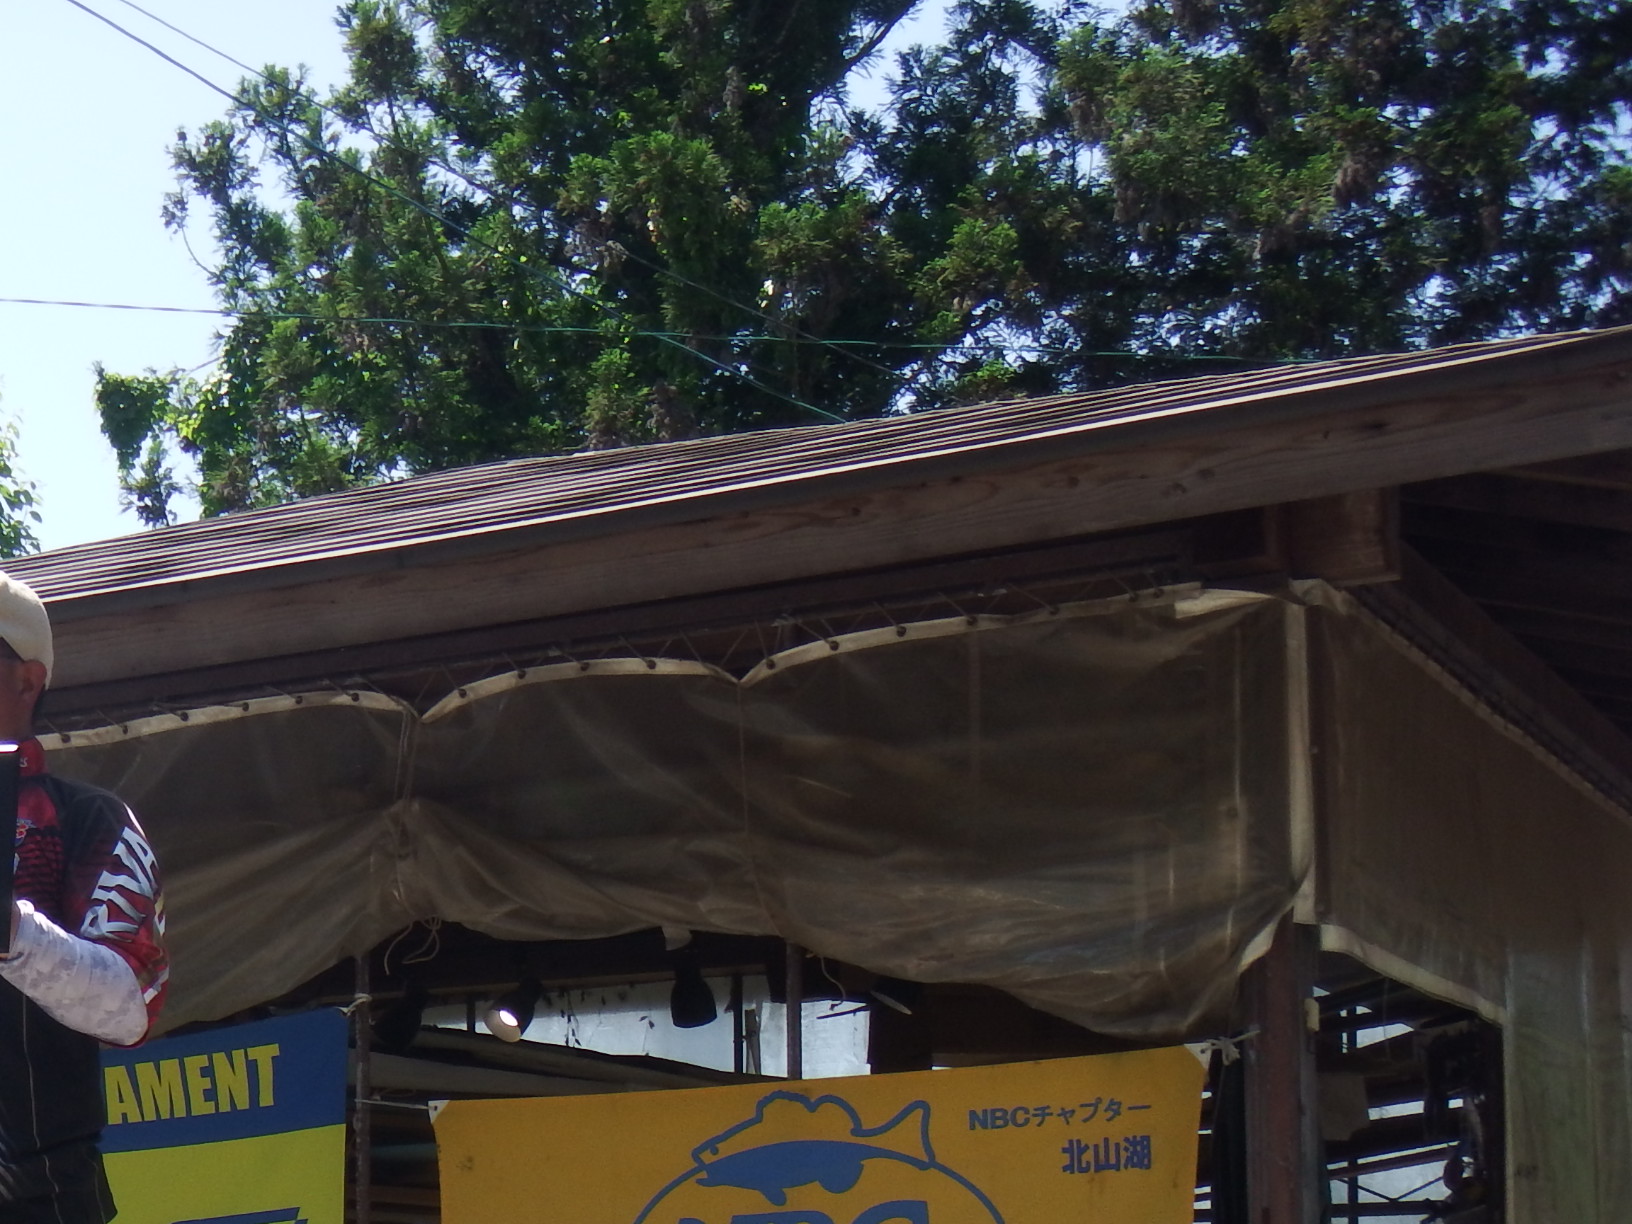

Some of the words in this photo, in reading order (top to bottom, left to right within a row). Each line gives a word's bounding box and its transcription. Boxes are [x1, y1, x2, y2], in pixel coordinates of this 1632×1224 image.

[80, 826, 160, 942] RIVA
[105, 1043, 280, 1126] AMENT
[969, 1097, 1152, 1130] NBCチャプター
[1061, 1135, 1152, 1175] 北山湖
